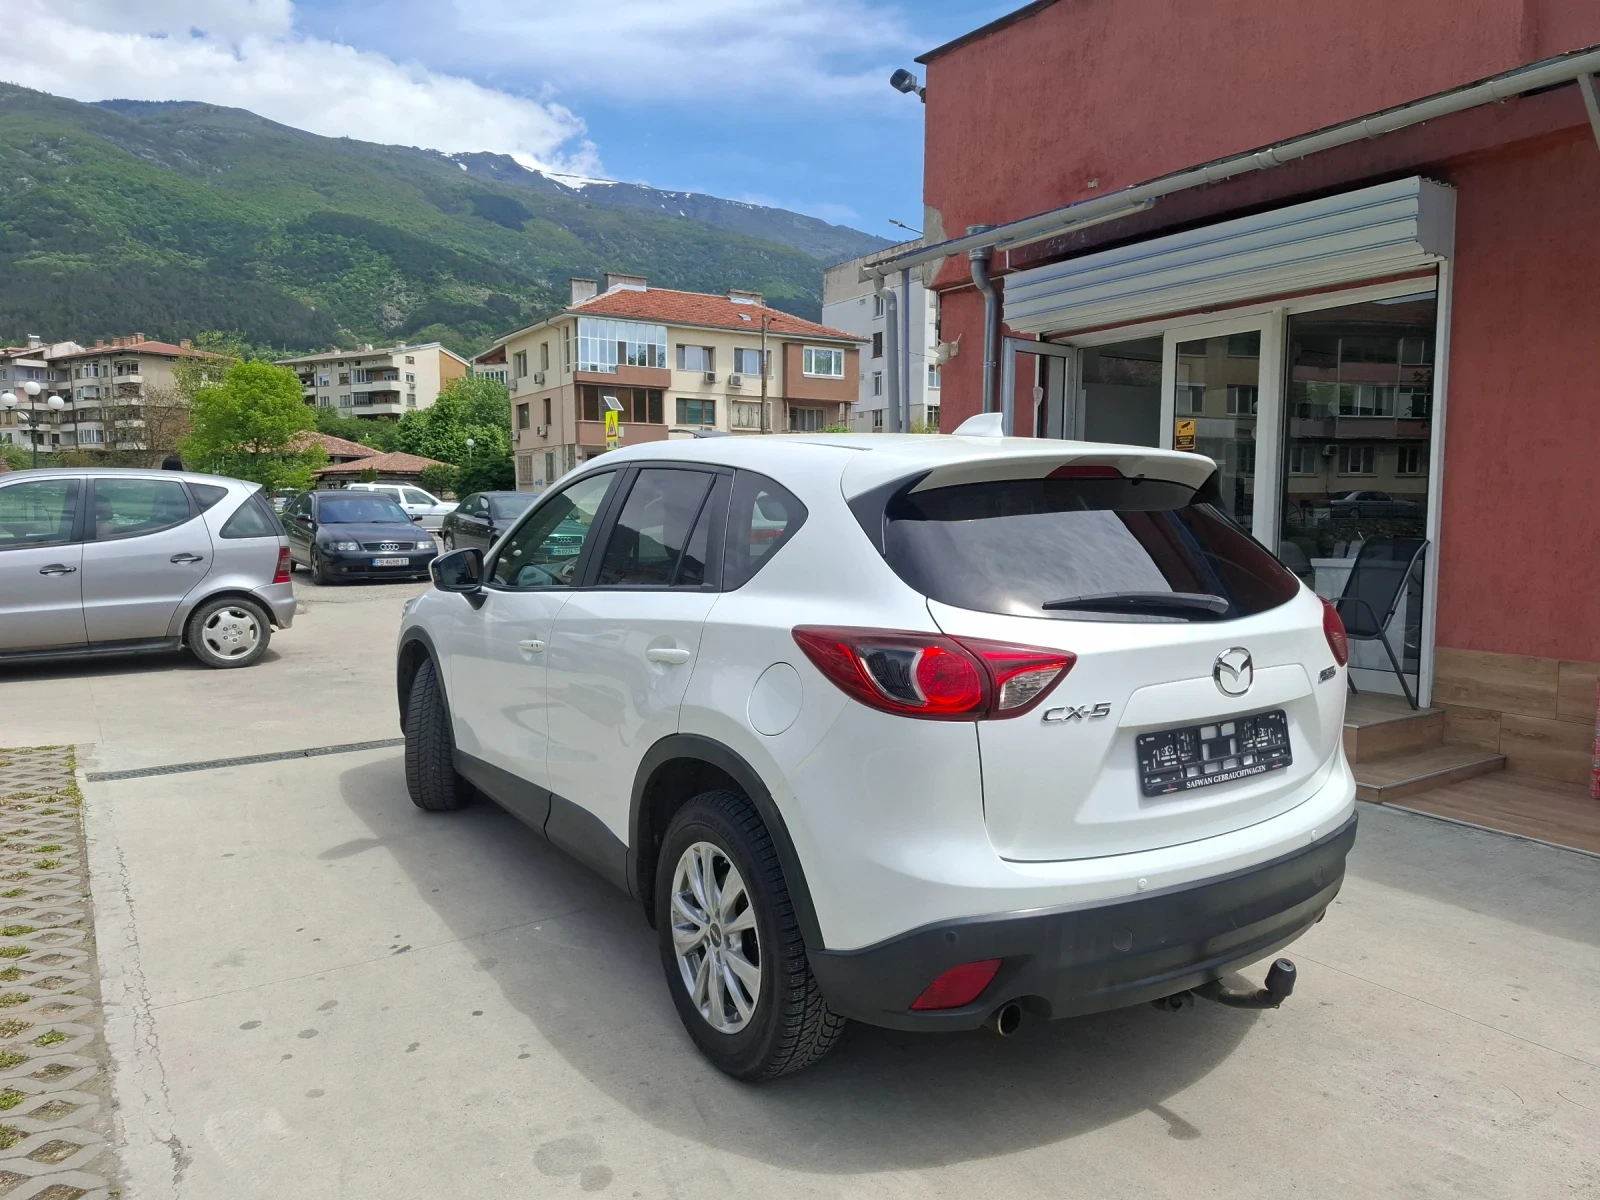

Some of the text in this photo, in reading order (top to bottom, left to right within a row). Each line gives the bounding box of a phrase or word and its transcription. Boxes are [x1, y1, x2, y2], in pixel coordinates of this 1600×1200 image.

[1042, 701, 1112, 723] CX-5
[1186, 764, 1266, 789] SAFWAN GEBRAUCHTWAGEN
